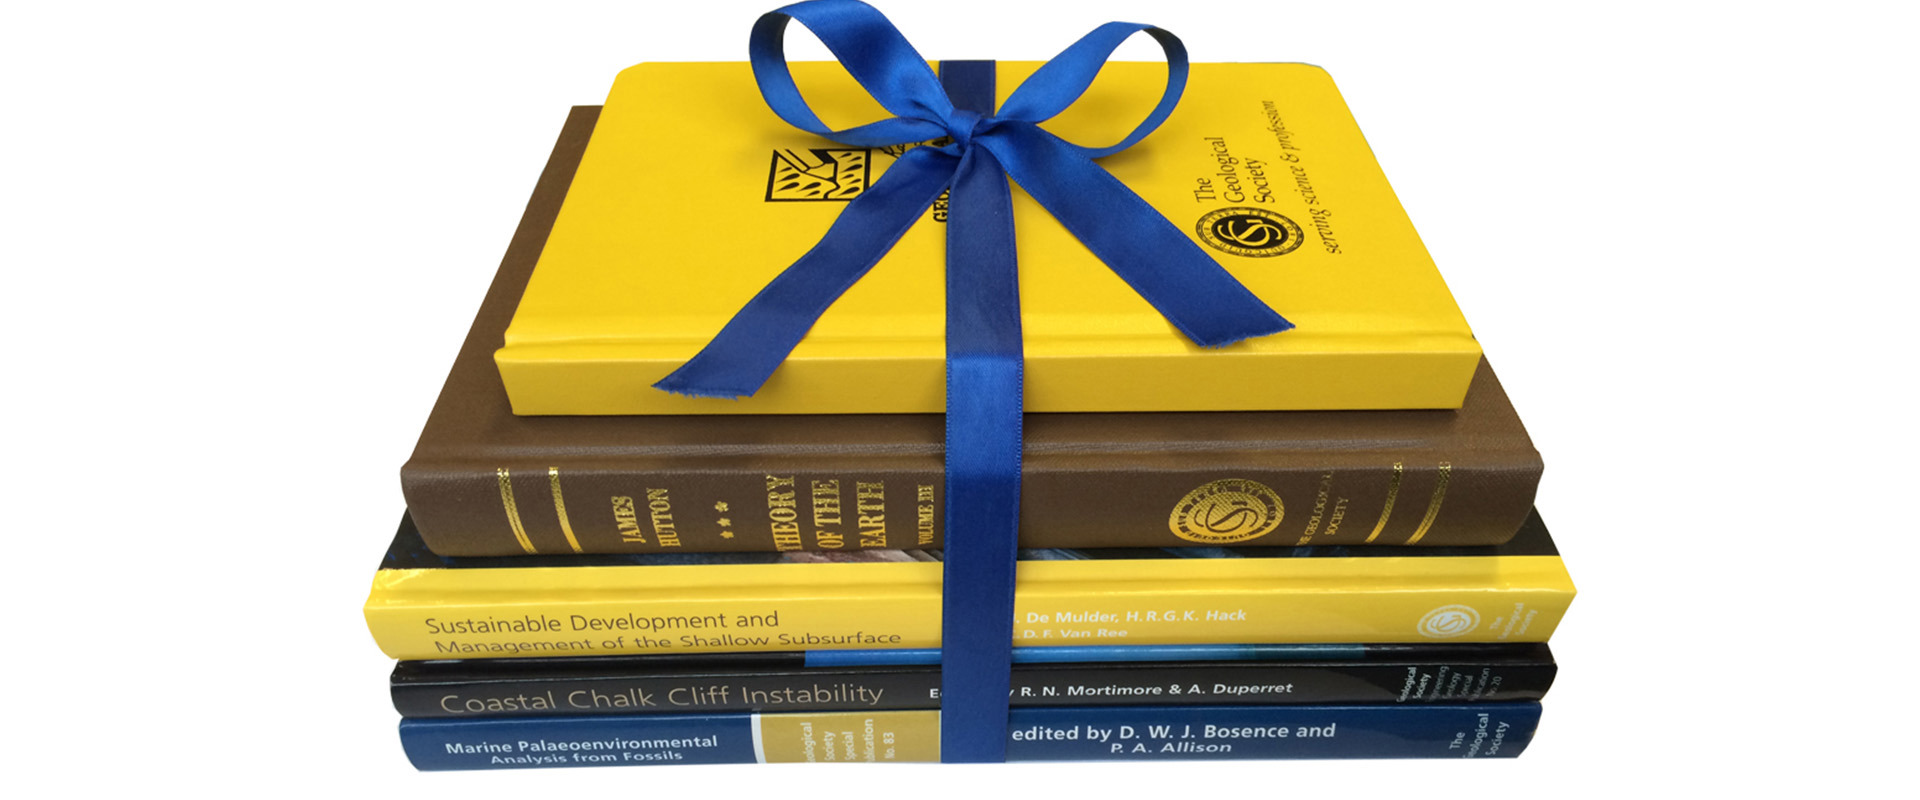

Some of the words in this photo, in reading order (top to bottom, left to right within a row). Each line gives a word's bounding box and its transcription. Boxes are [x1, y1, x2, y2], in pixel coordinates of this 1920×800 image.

[1261, 100, 1300, 151] profession
[1204, 136, 1246, 203] Geological
[1280, 152, 1300, 164] &
[1193, 177, 1217, 203] The
[1245, 158, 1275, 204] Society
[1290, 165, 1320, 205] science
[1309, 209, 1342, 254] serving
[811, 479, 842, 525] THE
[918, 484, 934, 502] III
[611, 495, 646, 544] JAMES
[646, 487, 681, 548] HUTTON
[766, 475, 803, 551] THEORY
[856, 480, 887, 548] EARTH
[918, 504, 934, 545] VOLUME
[1324, 496, 1349, 535] SOCIETY
[817, 530, 845, 549] OF
[425, 614, 562, 635] Sustainable
[570, 612, 728, 632] Development
[736, 610, 779, 628] and
[1026, 612, 1049, 624] De
[1055, 610, 1119, 624] Mulder,
[1206, 609, 1247, 621] Hack
[434, 637, 592, 654] Management
[602, 636, 624, 650] of
[633, 635, 671, 648] the
[680, 634, 770, 648] Shallow
[778, 631, 901, 646] Subsurface
[1060, 629, 1091, 638] Van
[1097, 628, 1128, 638] Ree
[440, 690, 556, 714] Coastal
[568, 688, 657, 709] Chalk
[668, 685, 729, 706] Cliff
[742, 683, 884, 706] Instability
[1020, 686, 1036, 697] R.
[1042, 686, 1060, 697] N.
[1067, 684, 1162, 696] Mortimore
[1169, 684, 1182, 695] &
[1187, 684, 1206, 695] A.
[1213, 683, 1293, 696] Duperret
[1412, 673, 1432, 699] Society
[445, 741, 512, 755] Marine
[518, 735, 718, 753] Palaeoenvironmental
[883, 732, 895, 744] 83
[1012, 725, 1079, 741] edited
[1086, 725, 1112, 743] by
[1119, 725, 1140, 739] D.
[1148, 725, 1173, 739] W.
[1181, 725, 1196, 739] J.
[1204, 724, 1289, 739] Bosence
[1296, 722, 1337, 738] and
[1449, 732, 1465, 750] The
[1485, 722, 1510, 756] Society
[491, 754, 567, 765] Analysis
[572, 752, 617, 763] from
[623, 750, 683, 762] Fossils
[1110, 743, 1124, 753] P.
[1131, 743, 1152, 753] A.
[1160, 742, 1232, 753] Allison
